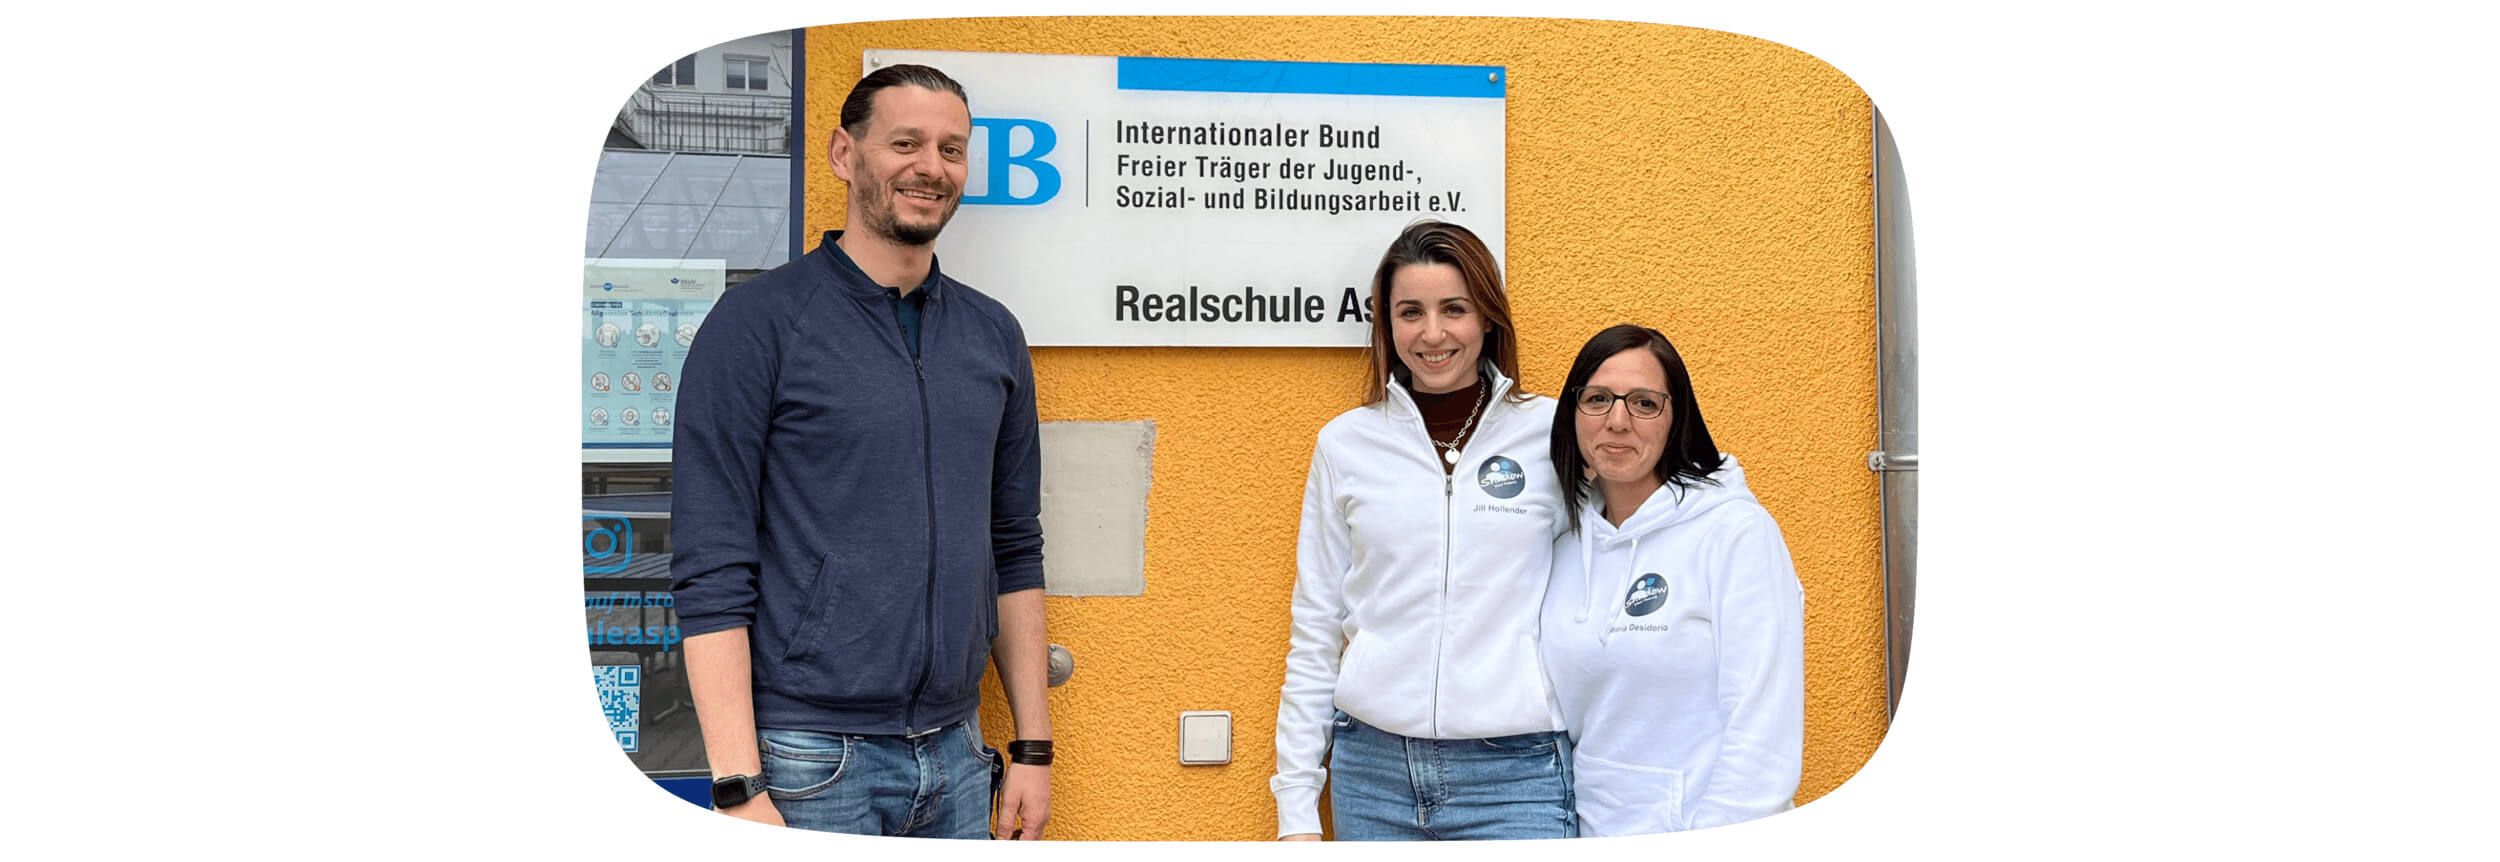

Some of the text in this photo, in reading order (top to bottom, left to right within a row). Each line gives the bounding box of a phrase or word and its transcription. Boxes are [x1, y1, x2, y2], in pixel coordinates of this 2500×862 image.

[1116, 119, 1380, 149] Internationaler Bund
[1117, 154, 1422, 185] Freier Träger der Jugend-,
[1116, 185, 1466, 216] Sozial- und Bildungsarbeit e.V.
[1116, 285, 1325, 323] Realschule
[1473, 503, 1528, 515] Jill Hollender
